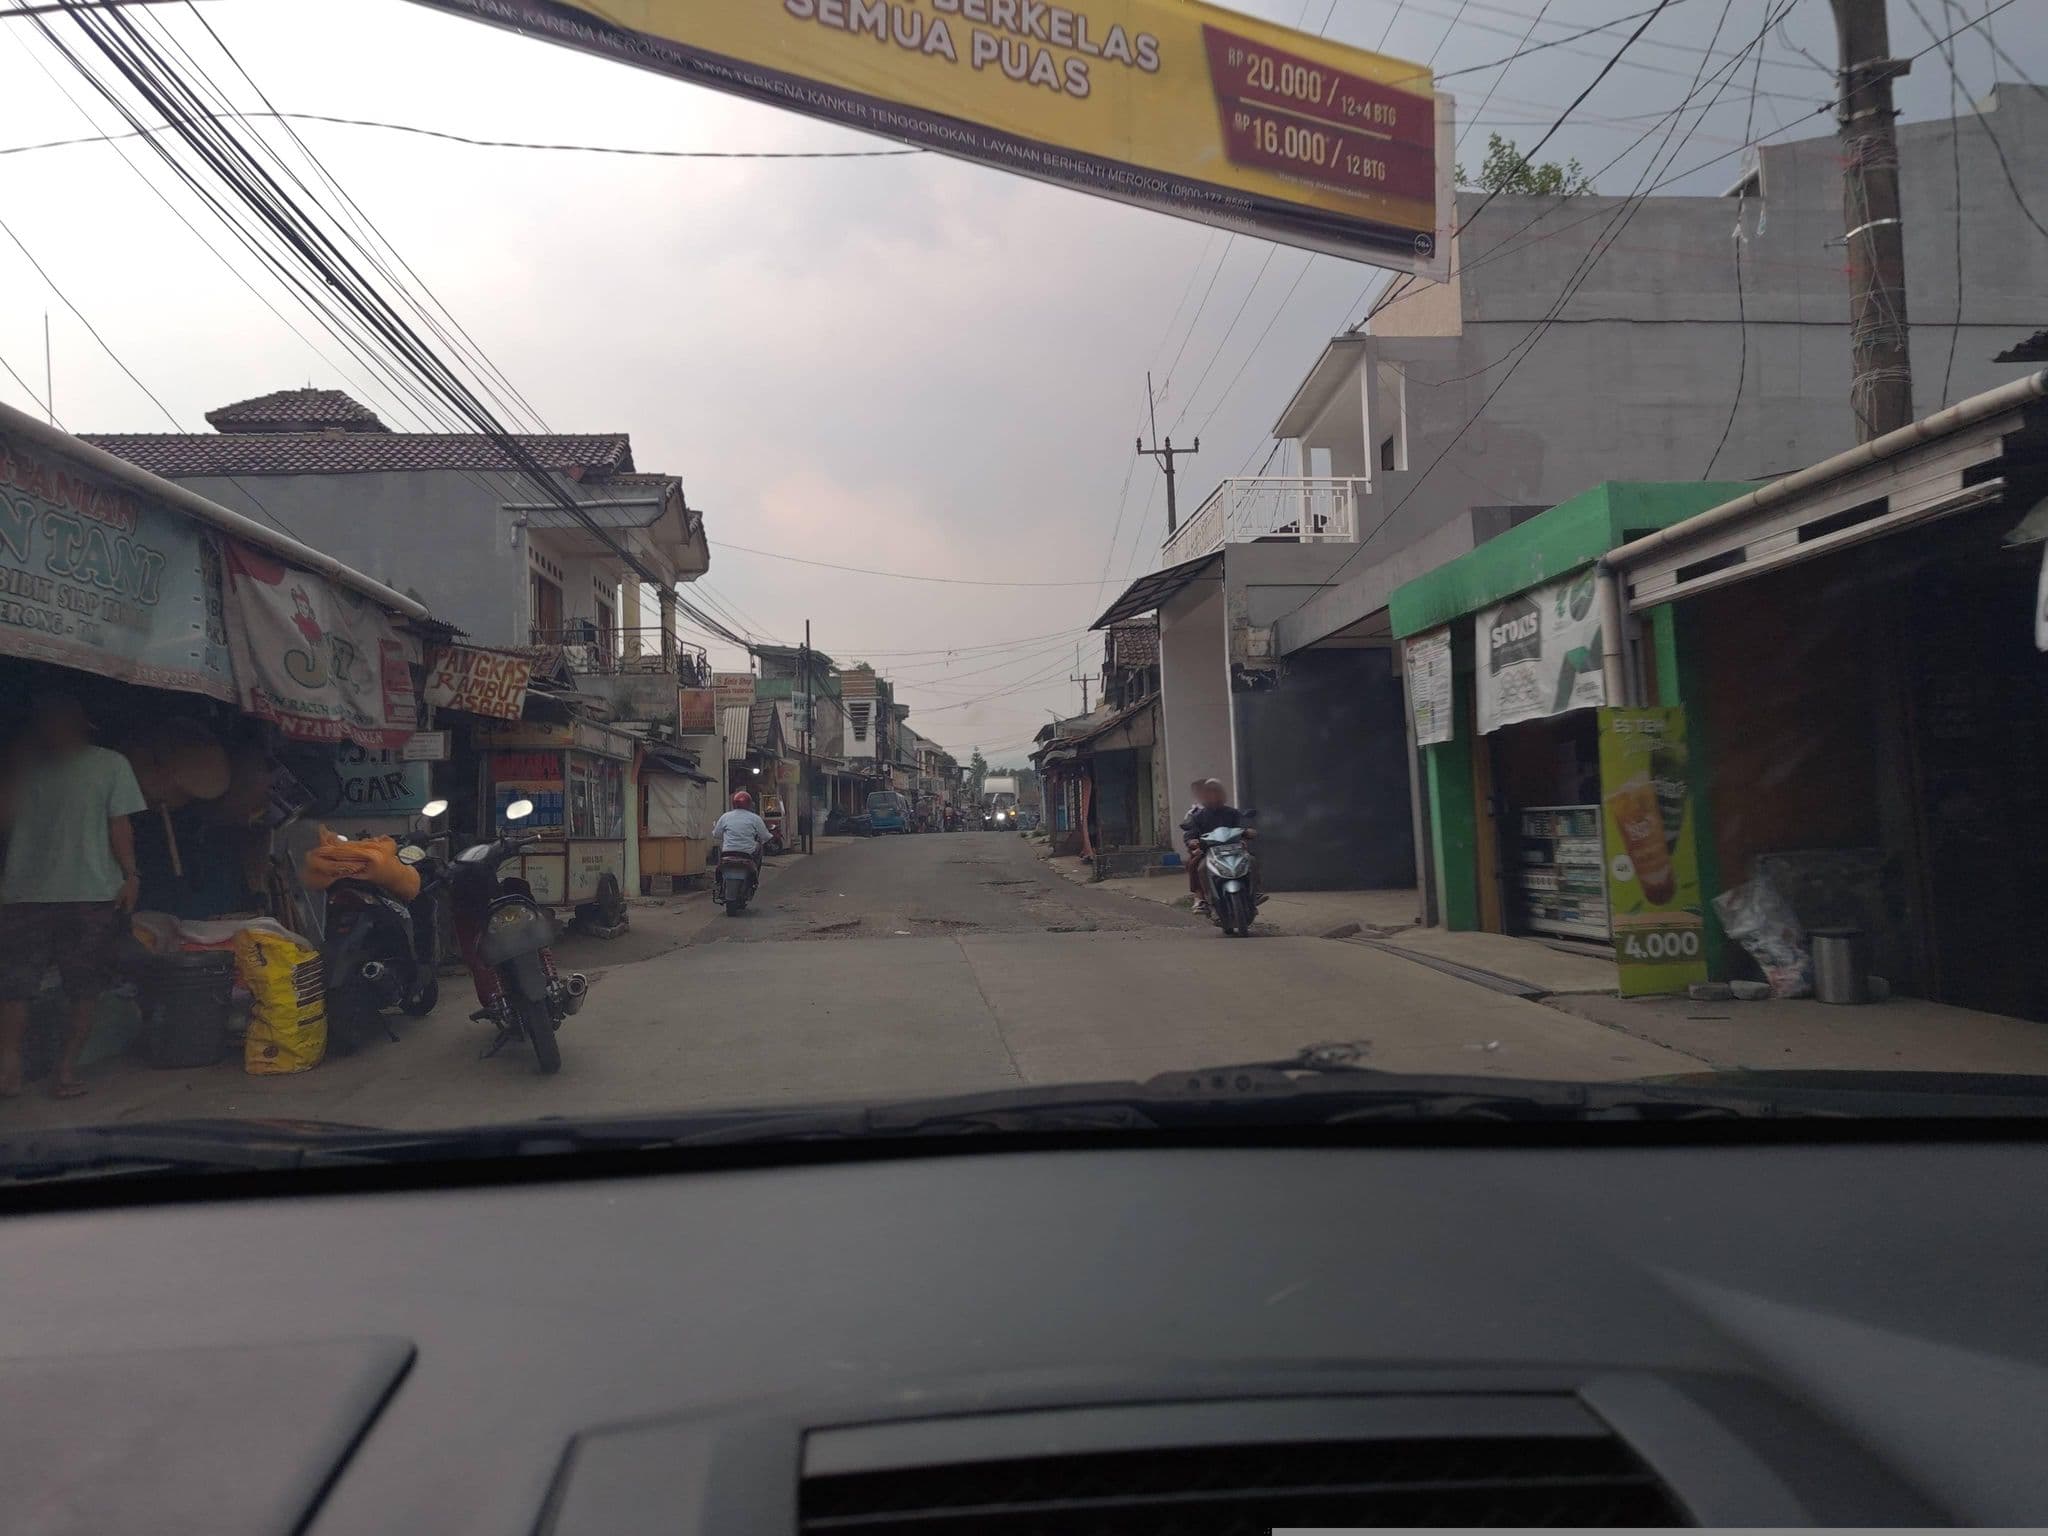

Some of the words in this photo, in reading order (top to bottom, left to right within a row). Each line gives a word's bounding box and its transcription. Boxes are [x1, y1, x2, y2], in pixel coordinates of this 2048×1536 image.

[933, 0, 1160, 72] ERKELAS
[972, 28, 1091, 97] PUAS
[1228, 47, 1244, 68] RP
[1374, 102, 1397, 127] BTG
[807, 89, 866, 118] KANKER
[1043, 151, 1105, 177] BERHENTI
[1107, 167, 1168, 193] MEROKOK
[1234, 112, 1250, 132] RP
[1346, 154, 1360, 175] 12
[1363, 159, 1386, 182] BTG
[42, 510, 166, 605] TANI
[431, 671, 526, 705] RAMBUT
[1625, 930, 1699, 958] 4.000
